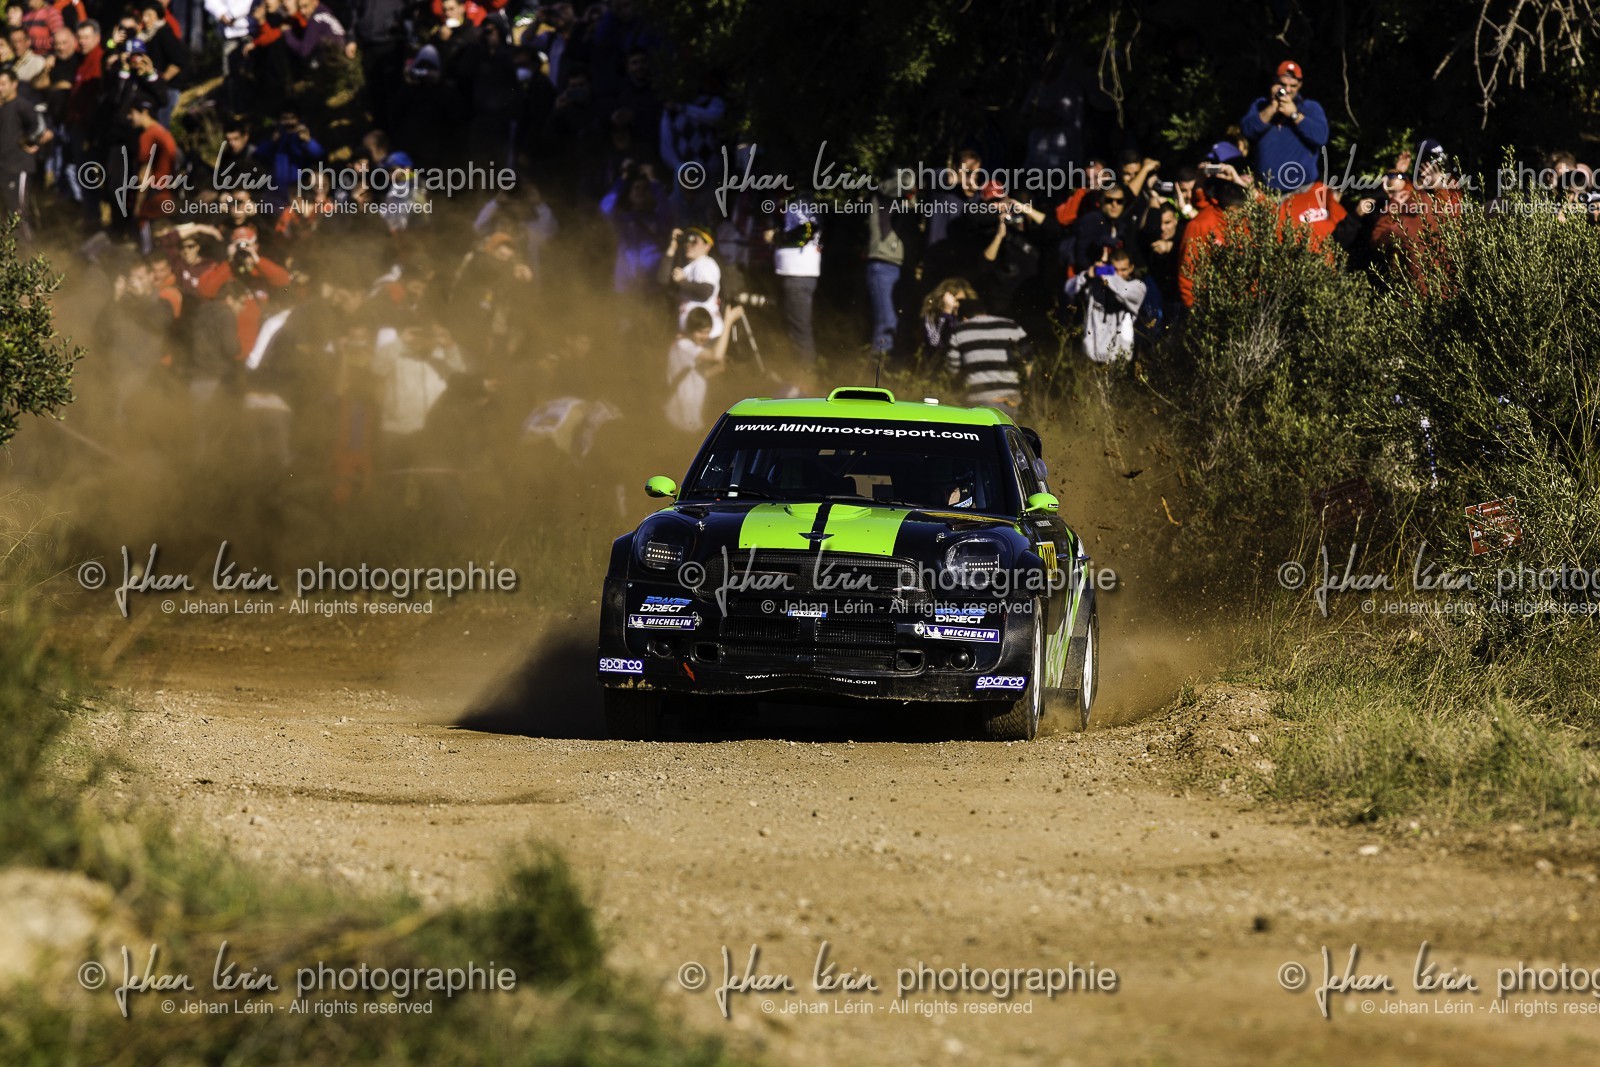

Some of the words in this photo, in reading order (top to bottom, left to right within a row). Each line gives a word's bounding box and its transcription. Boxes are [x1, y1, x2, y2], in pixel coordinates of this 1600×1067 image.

[734, 423, 980, 441] www.MINImotorsport.com
[640, 604, 686, 612] DIRECT
[645, 618, 692, 626] MICHELIN
[935, 615, 985, 624] DIRECT
[943, 629, 995, 639] MICHELIN
[600, 658, 643, 672] sparco
[977, 676, 1025, 688] sparco
